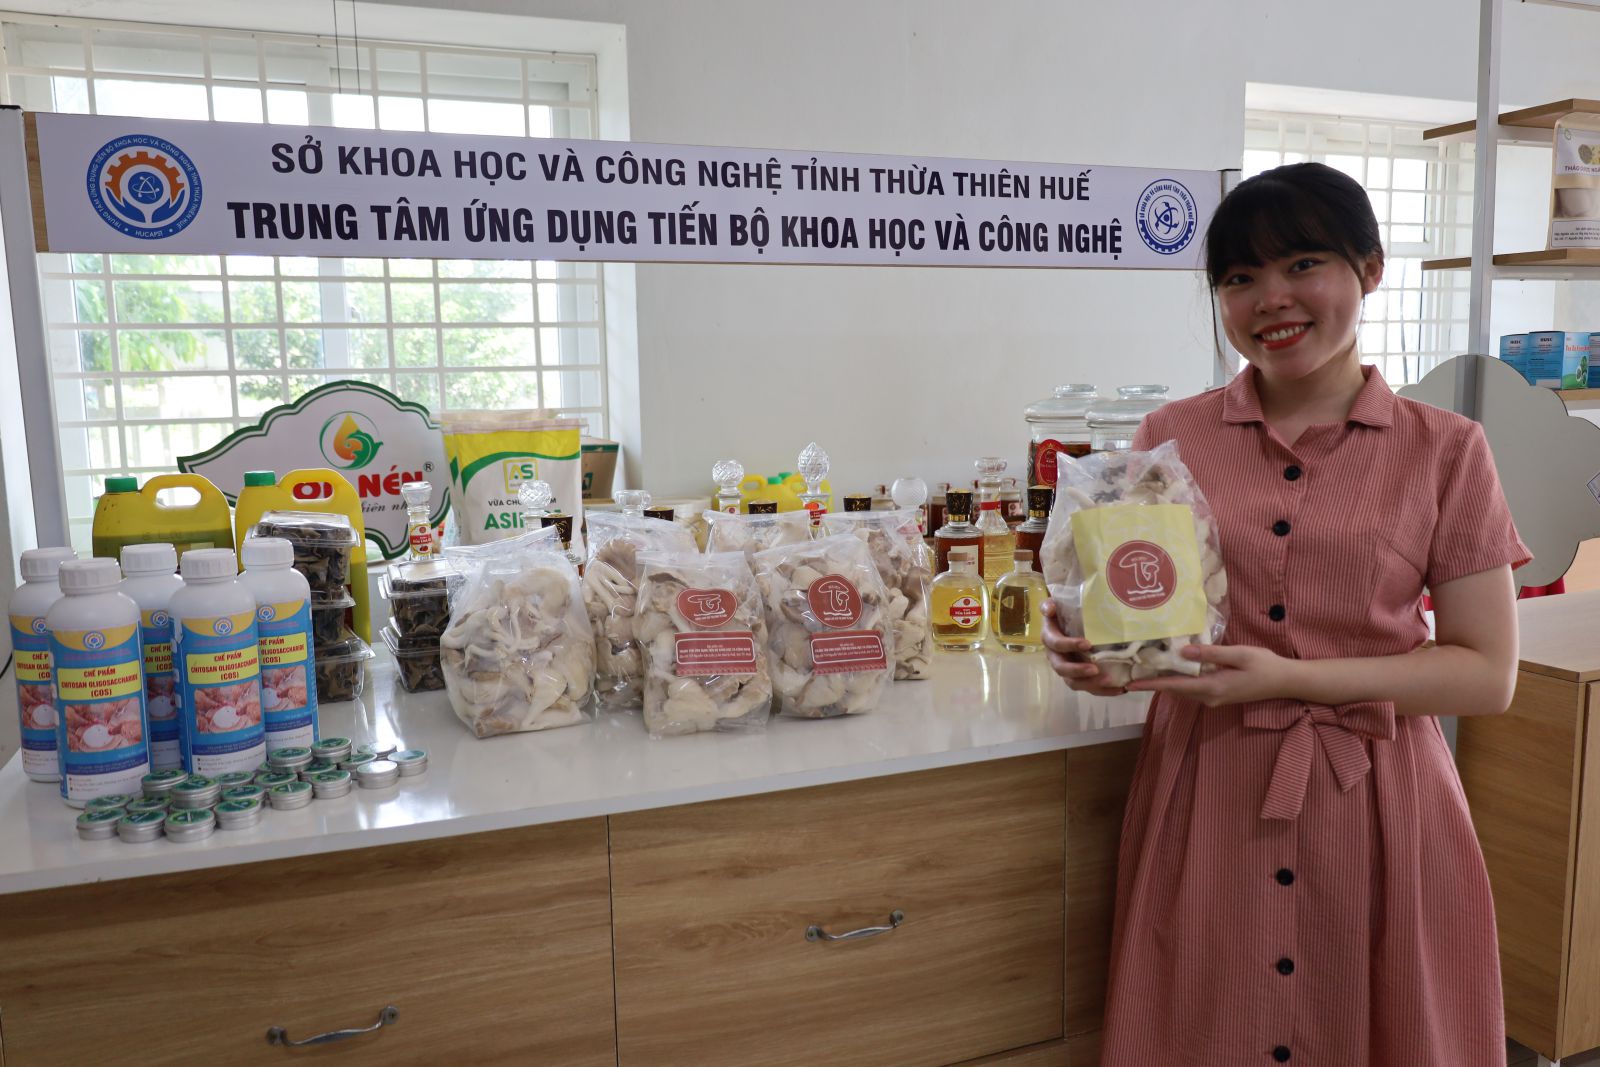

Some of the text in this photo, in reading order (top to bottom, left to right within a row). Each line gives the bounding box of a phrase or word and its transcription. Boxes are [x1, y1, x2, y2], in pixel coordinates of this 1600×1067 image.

[272, 134, 1092, 201] SỞ KHOA HỌC VÀ CÔNG NGHỆ TỈNH THỪA THIÊN HUẾ
[227, 197, 1123, 261] TRUNG TÂM ỨNG DỤNG TIẾN BỘ KHOA HỌC VÀ CÔNG NGHỆ
[361, 500, 386, 513] hiên
